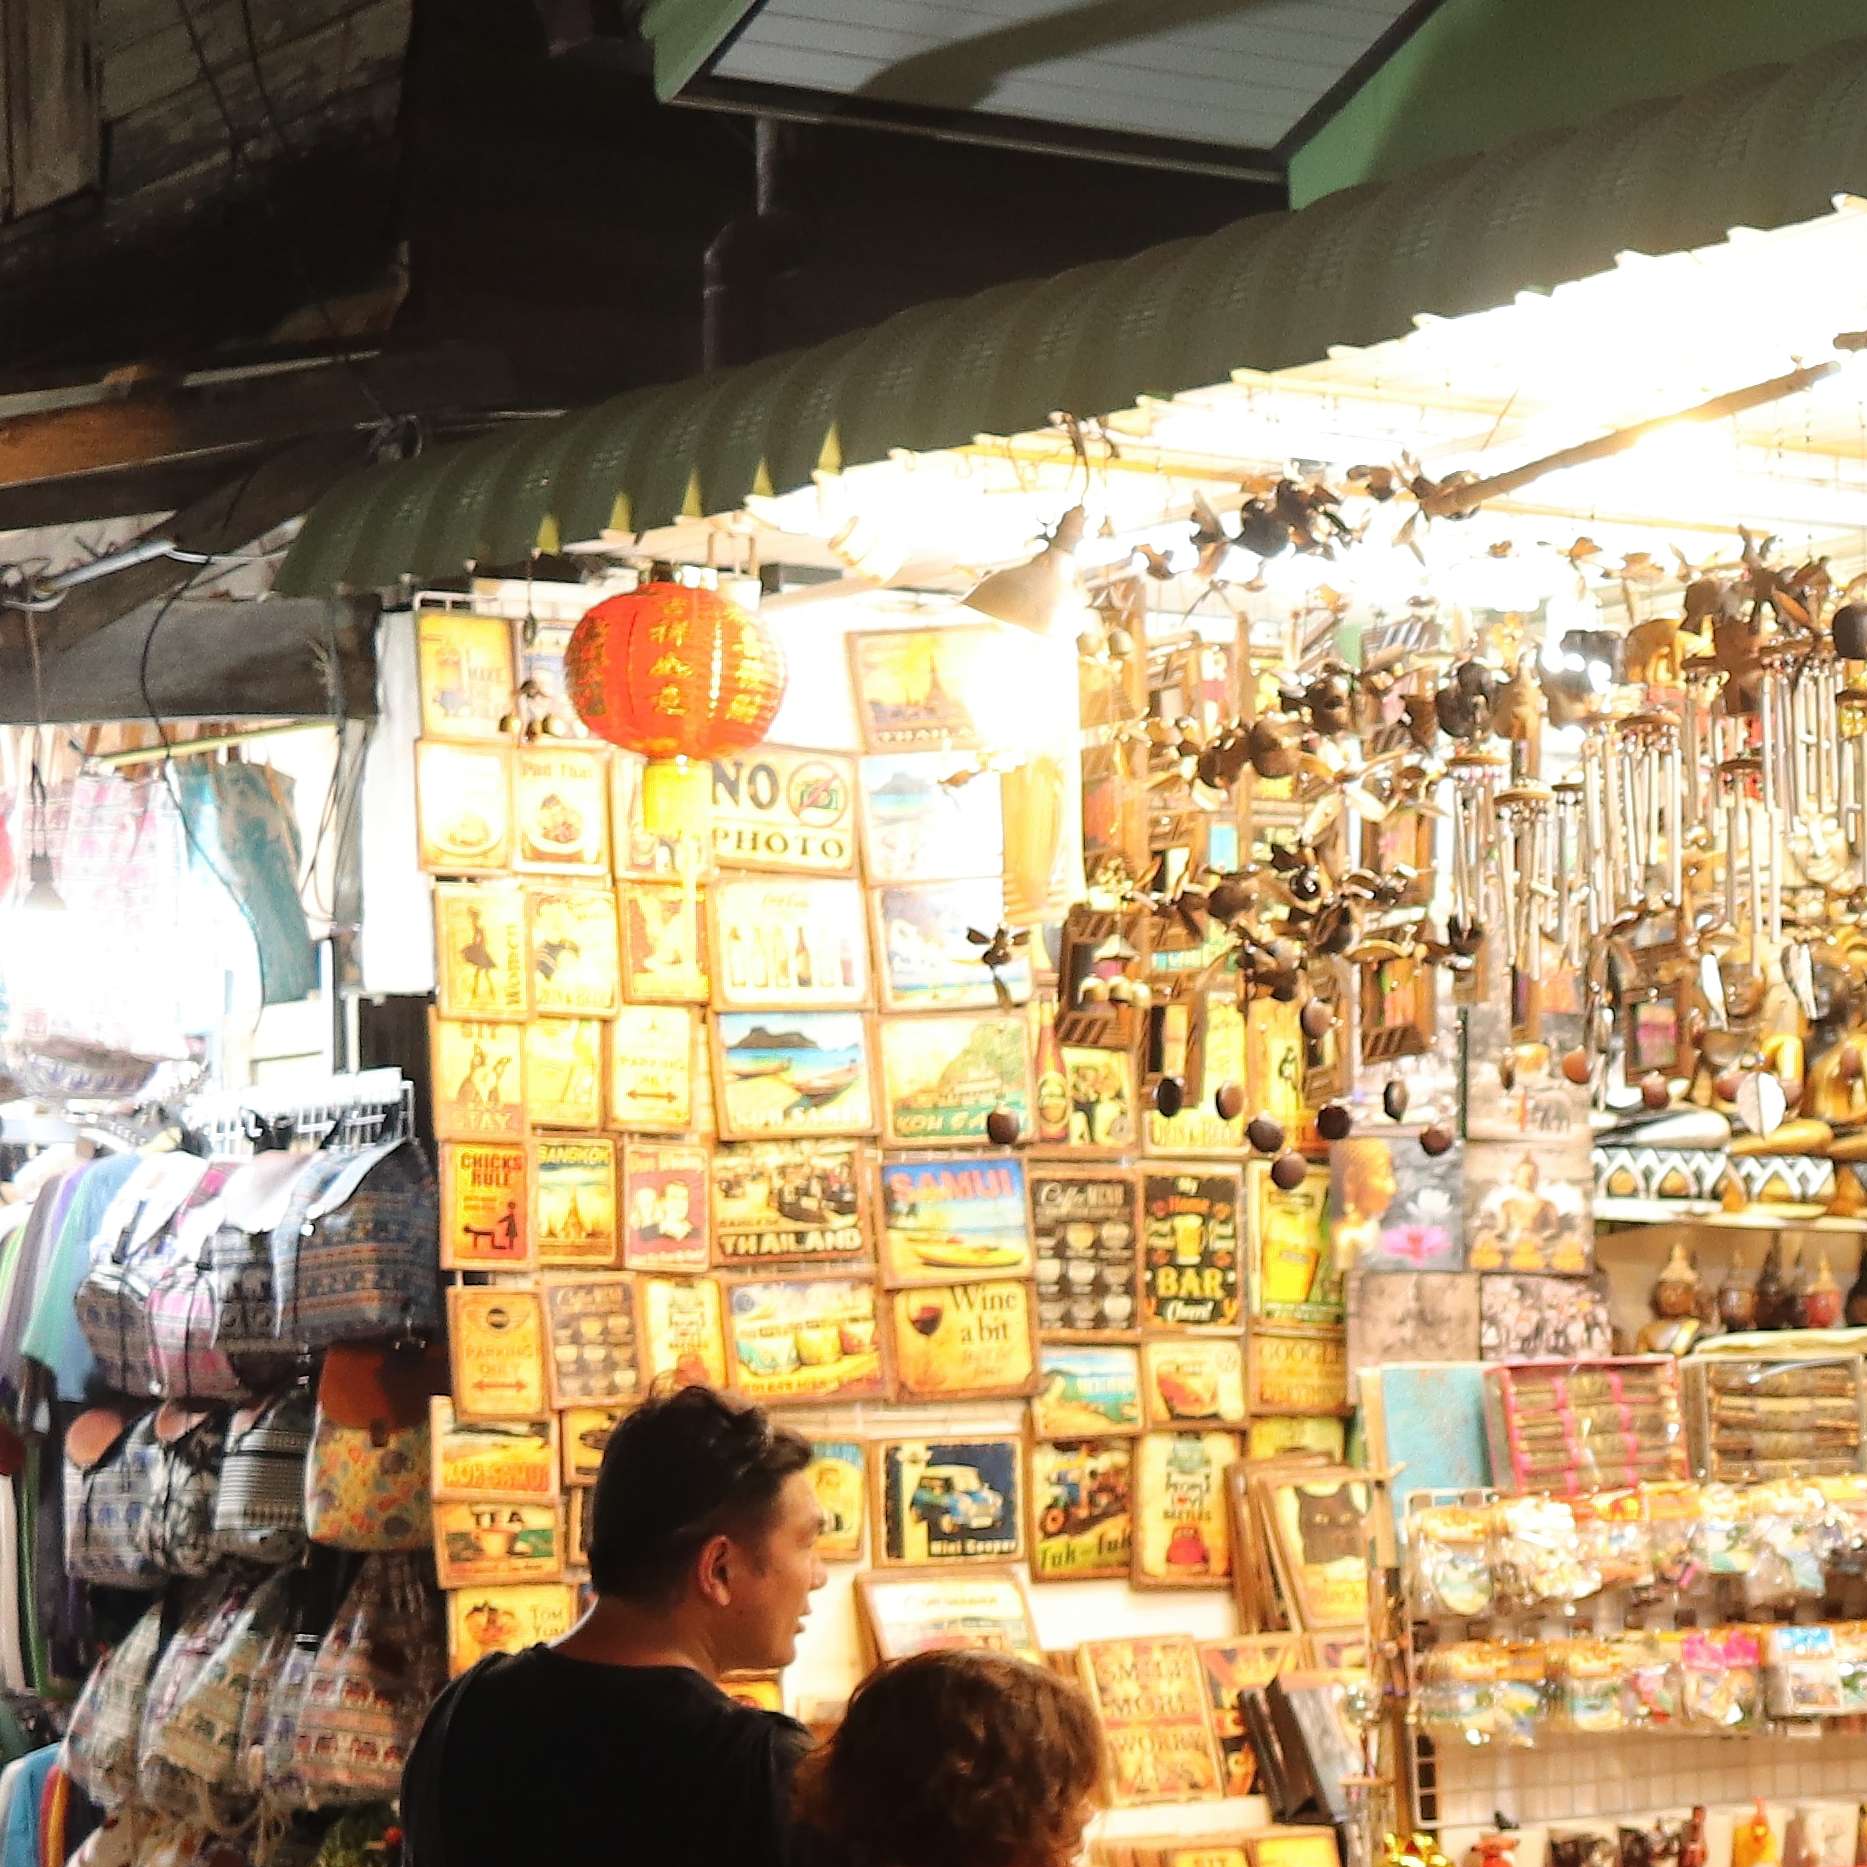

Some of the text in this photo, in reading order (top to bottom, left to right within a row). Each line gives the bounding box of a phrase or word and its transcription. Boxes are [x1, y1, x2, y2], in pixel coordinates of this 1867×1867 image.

[711, 758, 780, 810] NO
[711, 827, 844, 858] PHOTO
[461, 1153, 522, 1170] CHICKS
[890, 1168, 1014, 1201] SAMUI
[719, 1228, 862, 1256] THAILAND
[1156, 1265, 1227, 1300] BAR
[950, 1284, 1018, 1312] Wine
[961, 1313, 1009, 1343] a bit
